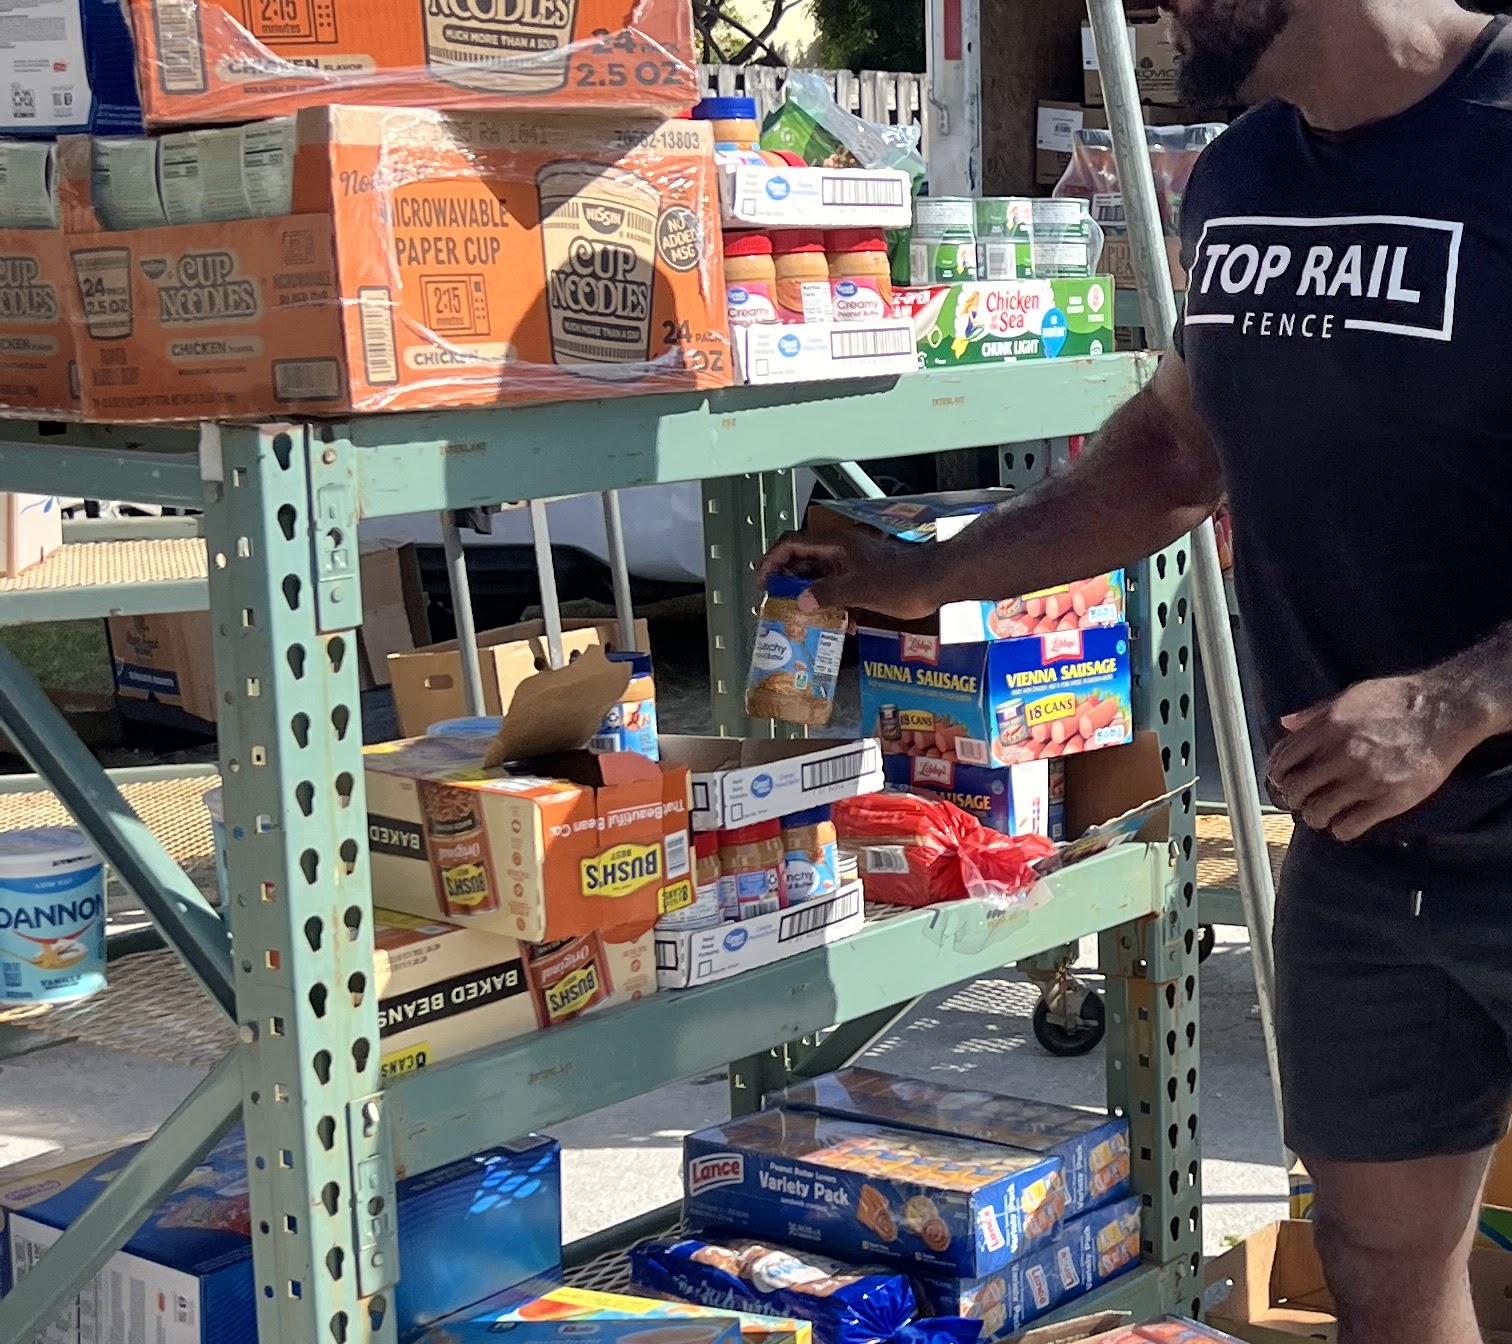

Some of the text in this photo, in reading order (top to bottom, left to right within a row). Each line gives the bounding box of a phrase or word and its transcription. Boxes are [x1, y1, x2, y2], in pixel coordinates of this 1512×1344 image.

[469, 31, 498, 45] MORE
[500, 33, 527, 47] THAN
[591, 28, 636, 54] 24
[576, 61, 683, 88] 2.5 OZ
[585, 206, 622, 227] NISSIN
[668, 218, 686, 233] NO
[396, 236, 501, 267] PAPER CUP
[661, 232, 698, 251] ADDED
[670, 246, 696, 262] MSG
[178, 253, 234, 286] CUP
[570, 237, 636, 283] CUP
[1199, 243, 1422, 304] TOP RAIL
[84, 277, 105, 297] 24
[434, 286, 462, 314] 2:15
[551, 269, 649, 320] NOODLES
[158, 280, 257, 323] NOODLES
[837, 299, 879, 311] Creamy
[986, 289, 1040, 313] Chicken
[661, 320, 693, 345] 24
[999, 312, 1025, 332] Sea
[1241, 311, 1336, 340] FENCE
[1014, 339, 1040, 354] LIGHT
[863, 660, 913, 683] VIENNA
[916, 669, 978, 694] SAUSAGE
[1005, 671, 1058, 690] VIENNA
[1060, 657, 1118, 680] SAUSAGE
[909, 714, 933, 727] CANS
[1028, 698, 1074, 722] 18 CANS
[572, 816, 606, 832] Bean
[369, 824, 421, 851] BAKED
[438, 841, 482, 860] Original
[585, 849, 659, 890] BUSH'S
[445, 872, 487, 897] BUSH'S
[541, 944, 590, 984] Original
[377, 967, 520, 1028] BAKED BEANS
[548, 970, 598, 1014] BUSH'S
[692, 1159, 741, 1185] Lance
[758, 1169, 850, 1207] Variety Pack
